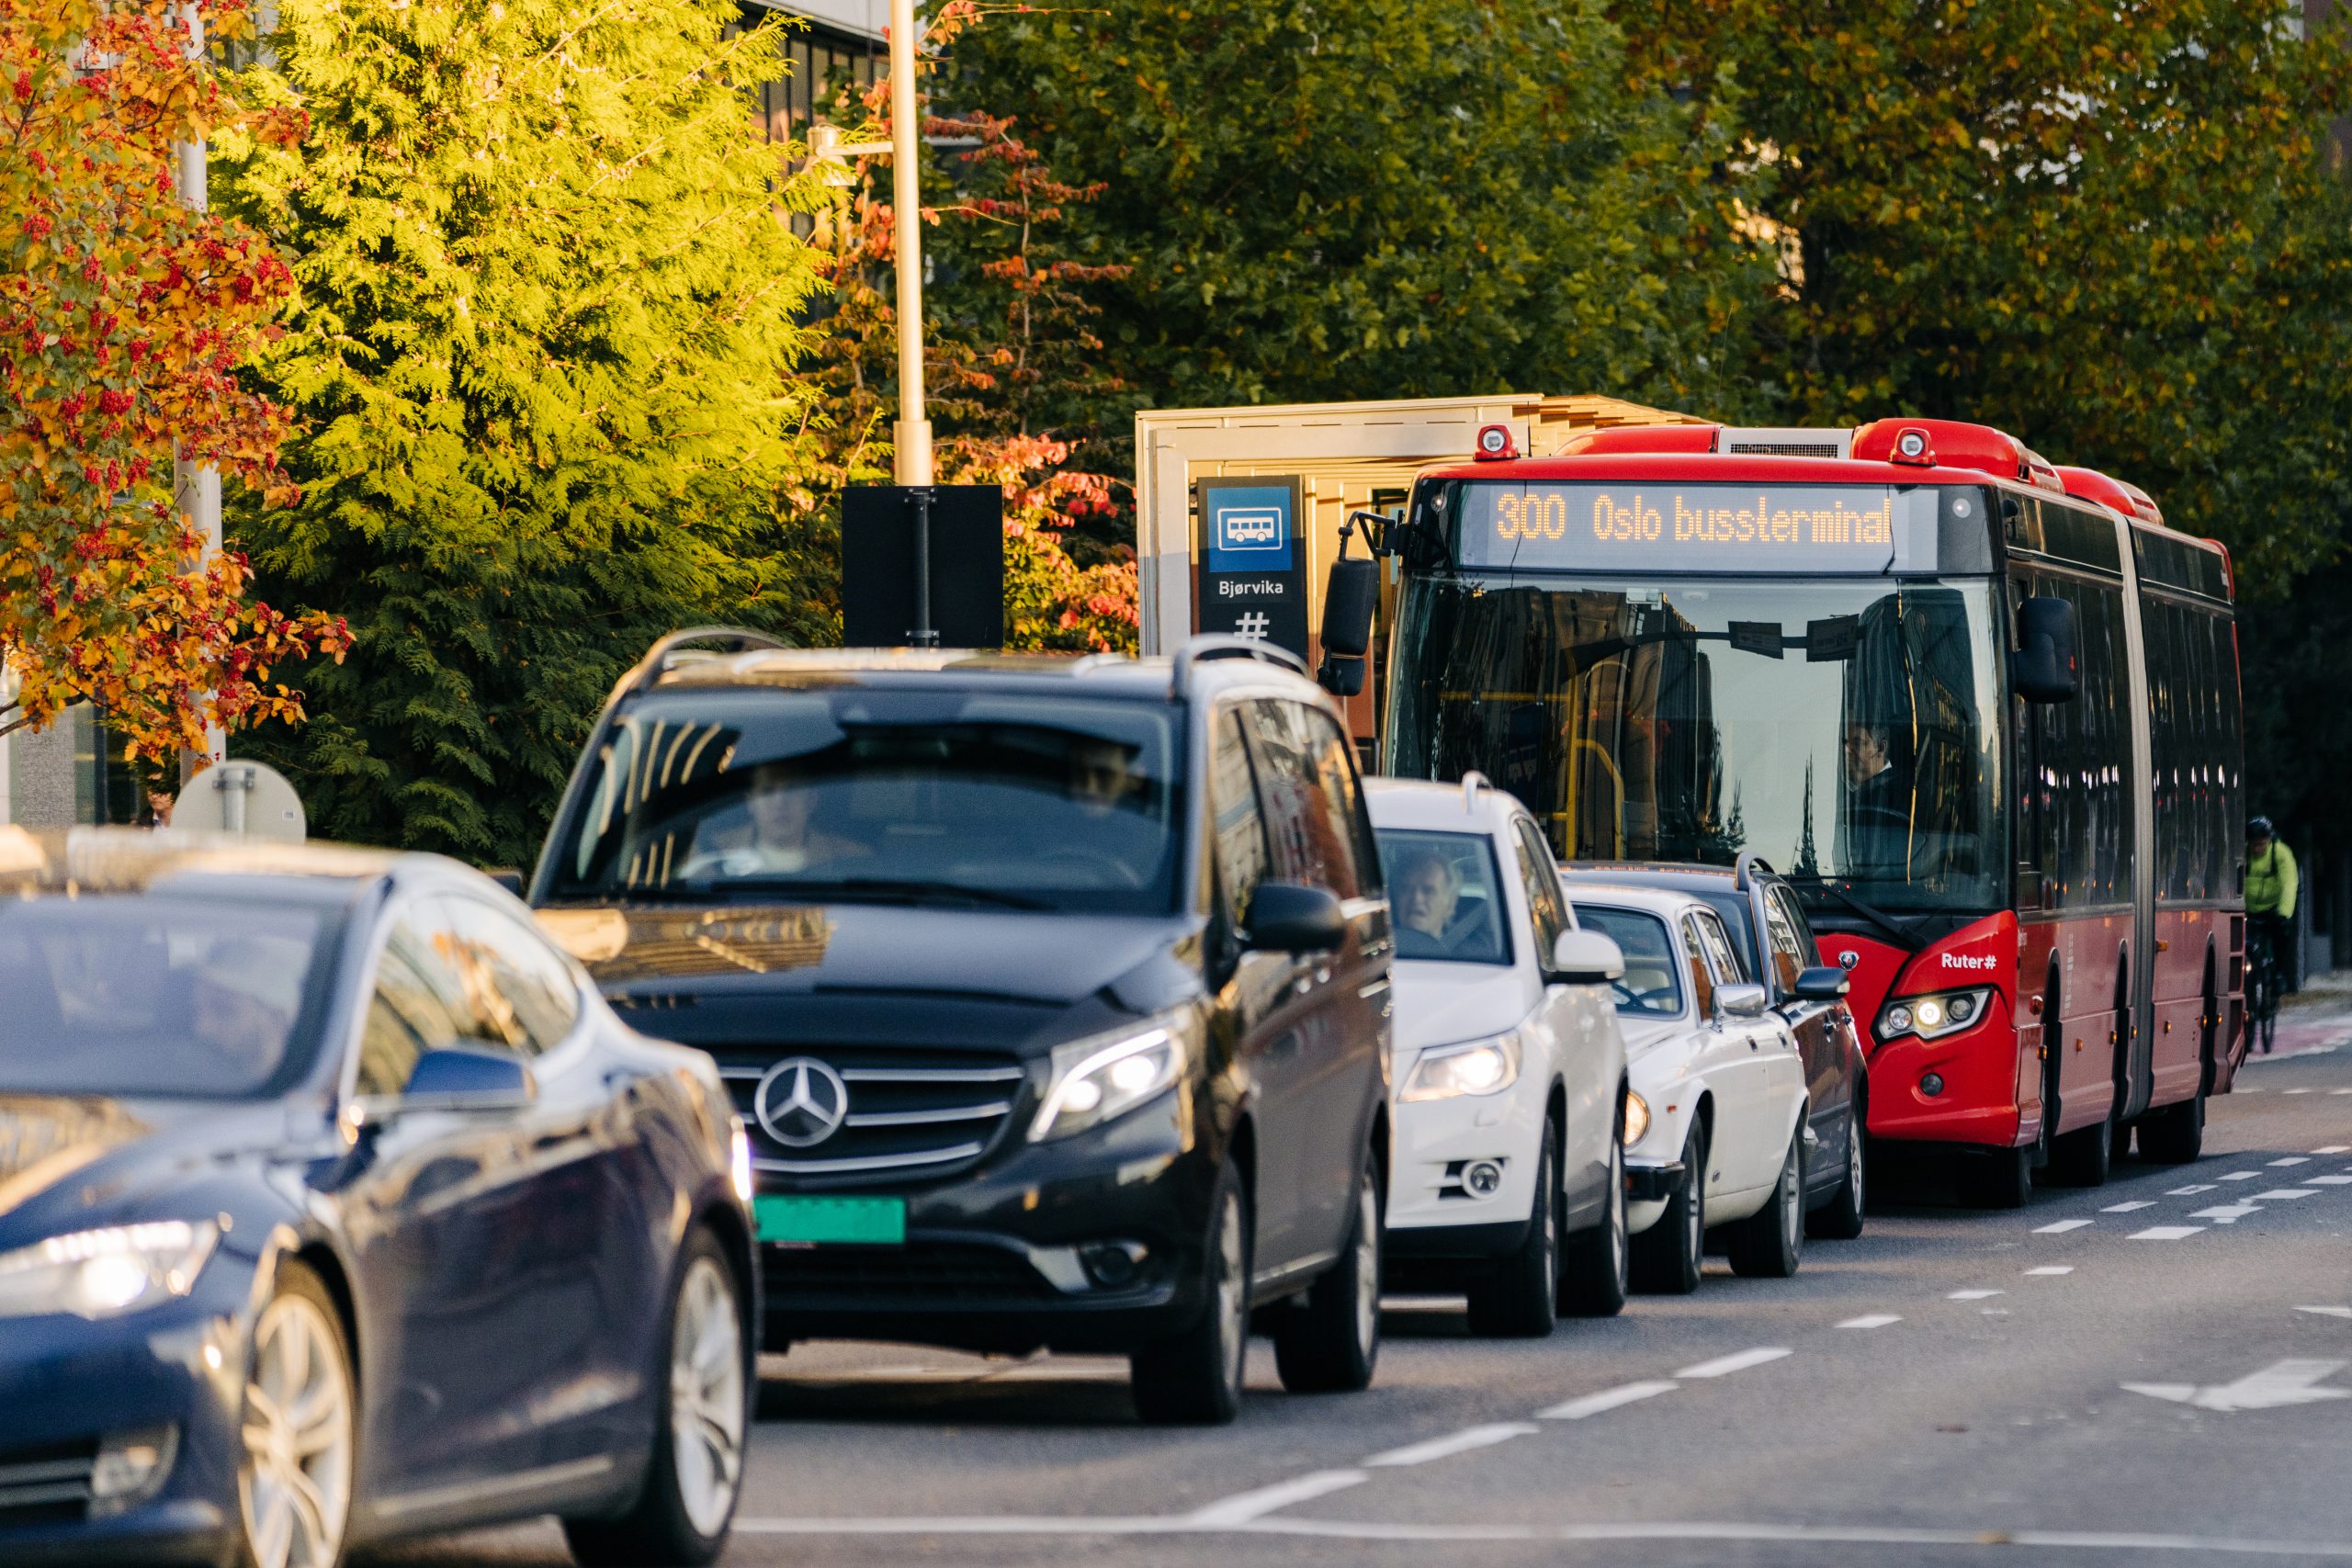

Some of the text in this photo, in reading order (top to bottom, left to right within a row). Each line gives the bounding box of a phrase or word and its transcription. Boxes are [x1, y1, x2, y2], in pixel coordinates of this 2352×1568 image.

[1497, 492, 1891, 544] 300 Oslo bussterminal
[1218, 581, 1283, 598] Bjørvika
[1941, 953, 1996, 970] Ruter#
